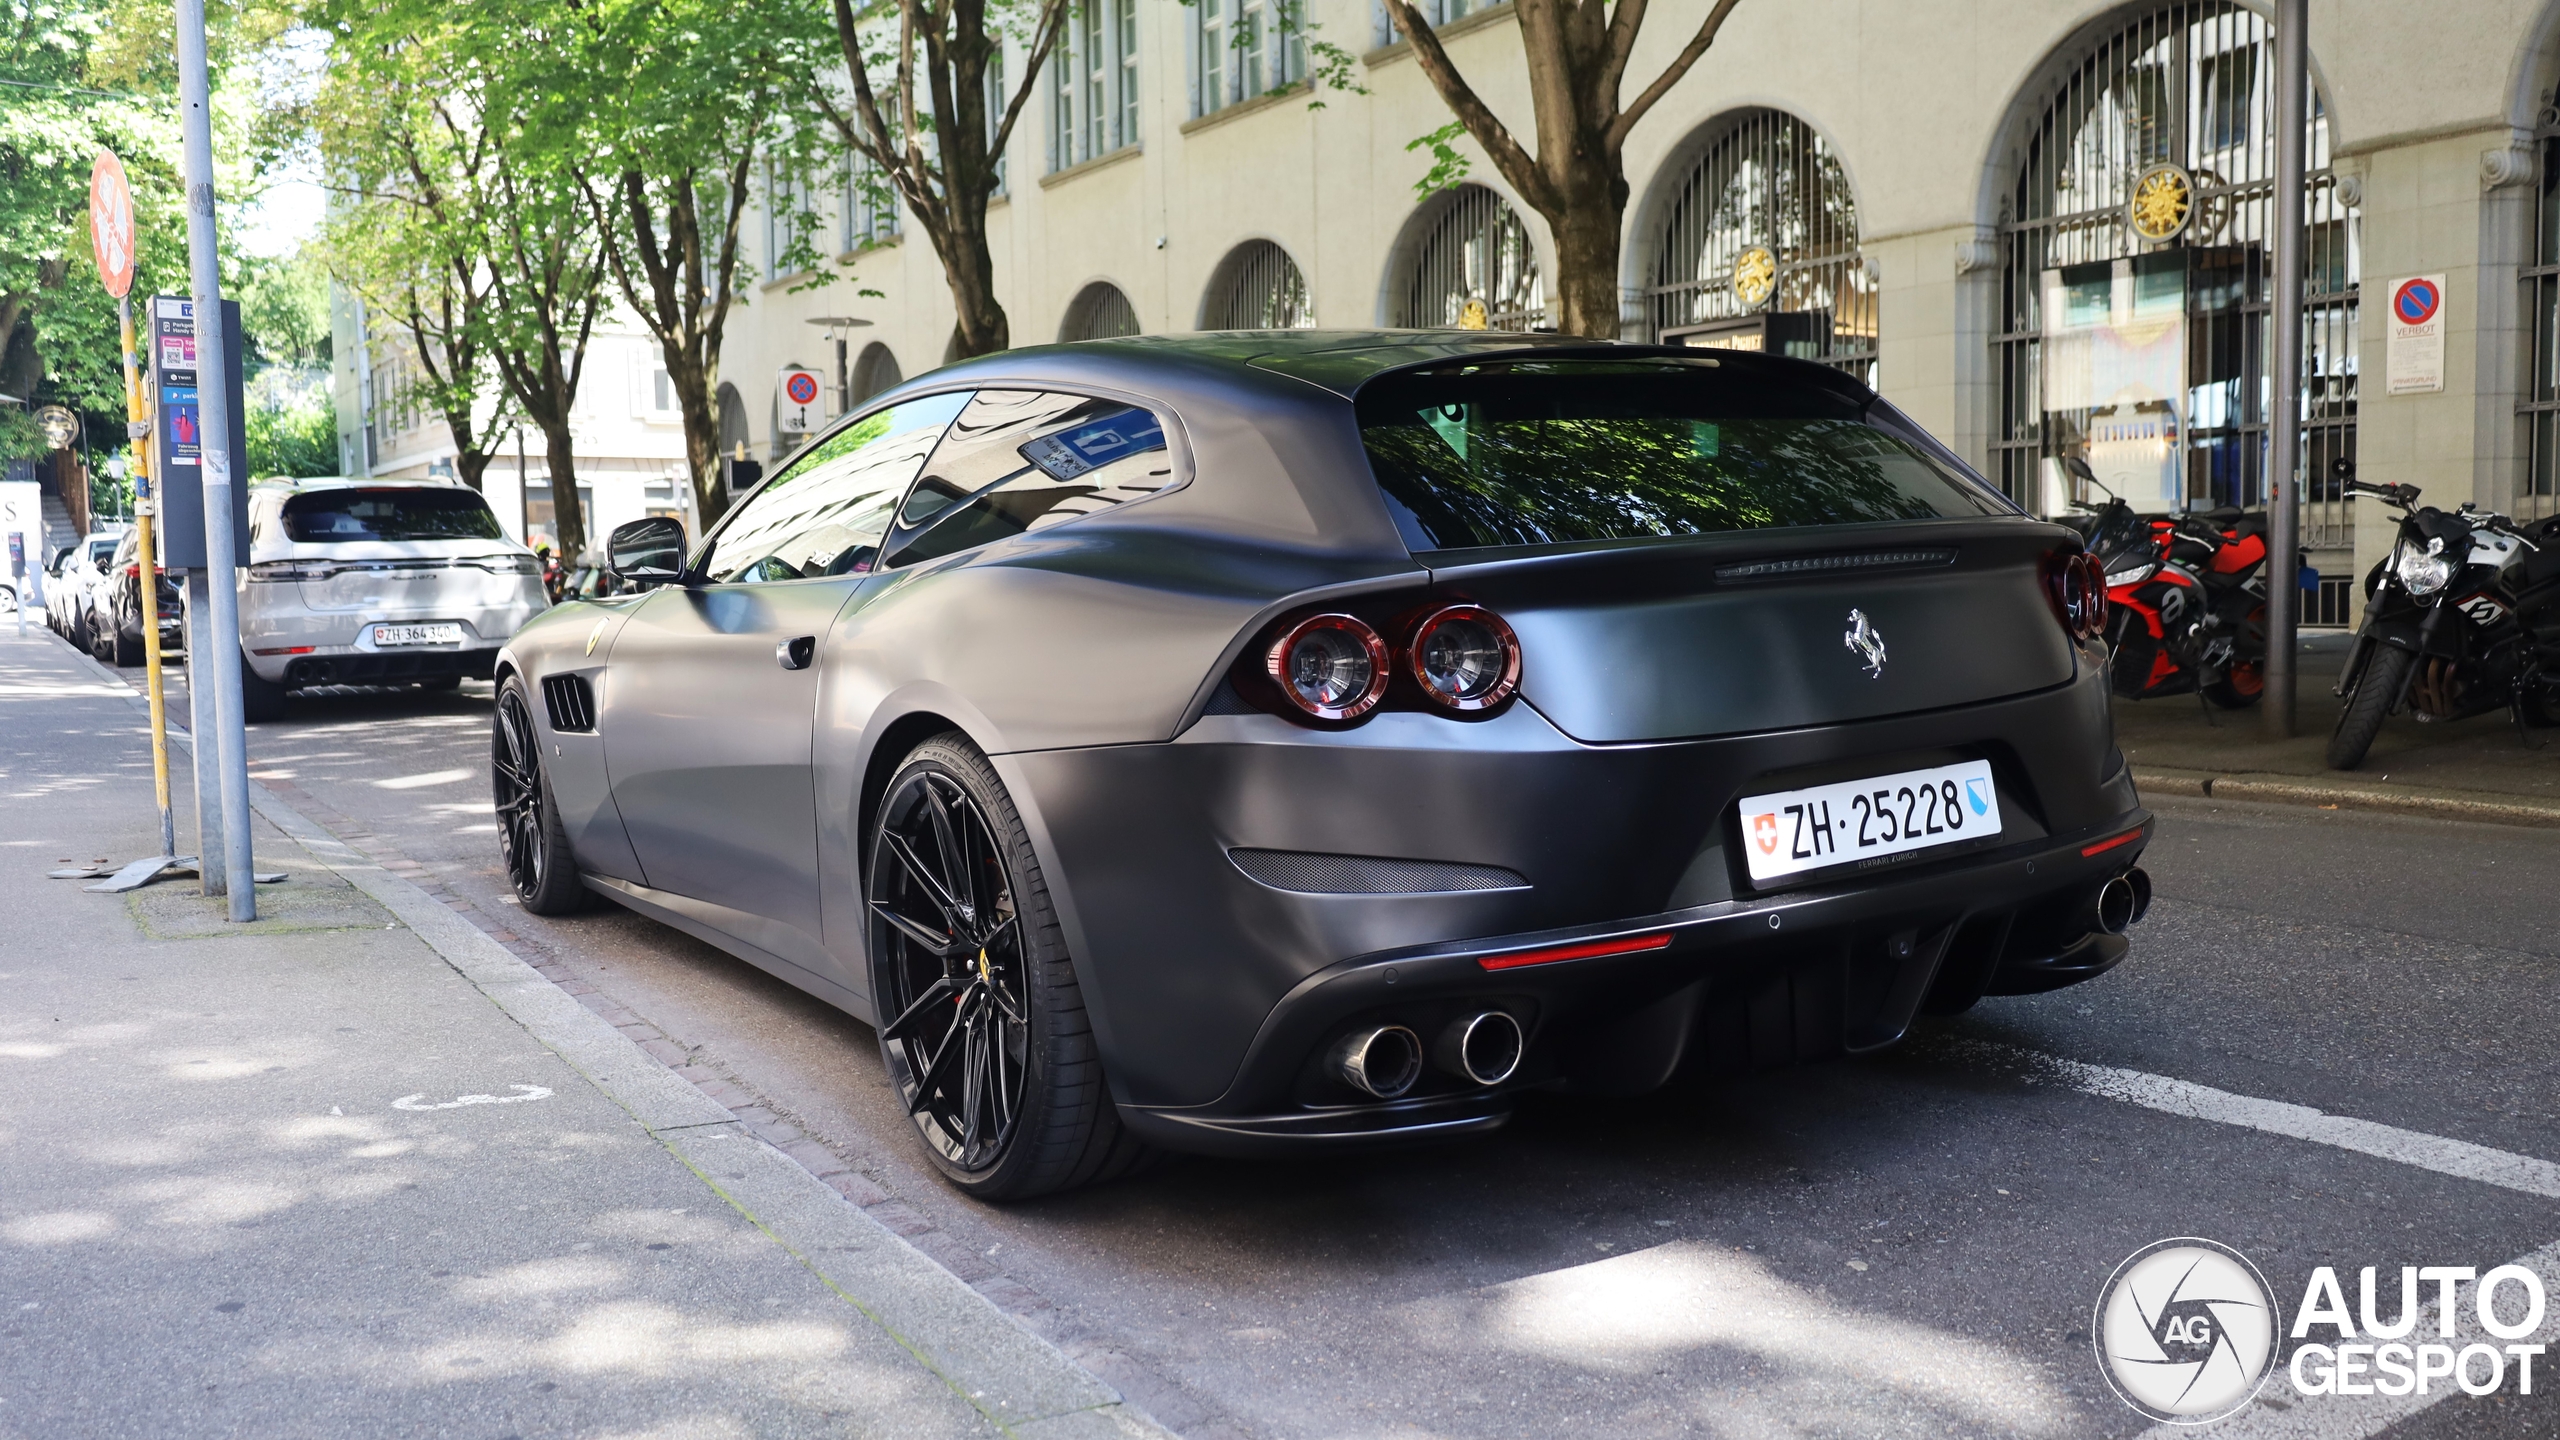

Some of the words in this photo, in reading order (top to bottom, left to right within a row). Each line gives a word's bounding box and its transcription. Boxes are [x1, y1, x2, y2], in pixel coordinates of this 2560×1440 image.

[2396, 324, 2436, 337] VERBOT
[2392, 375, 2437, 386] PRIVATGRUND
[1857, 857, 1890, 869] FERRARI
[1890, 850, 1918, 863] ZURICH
